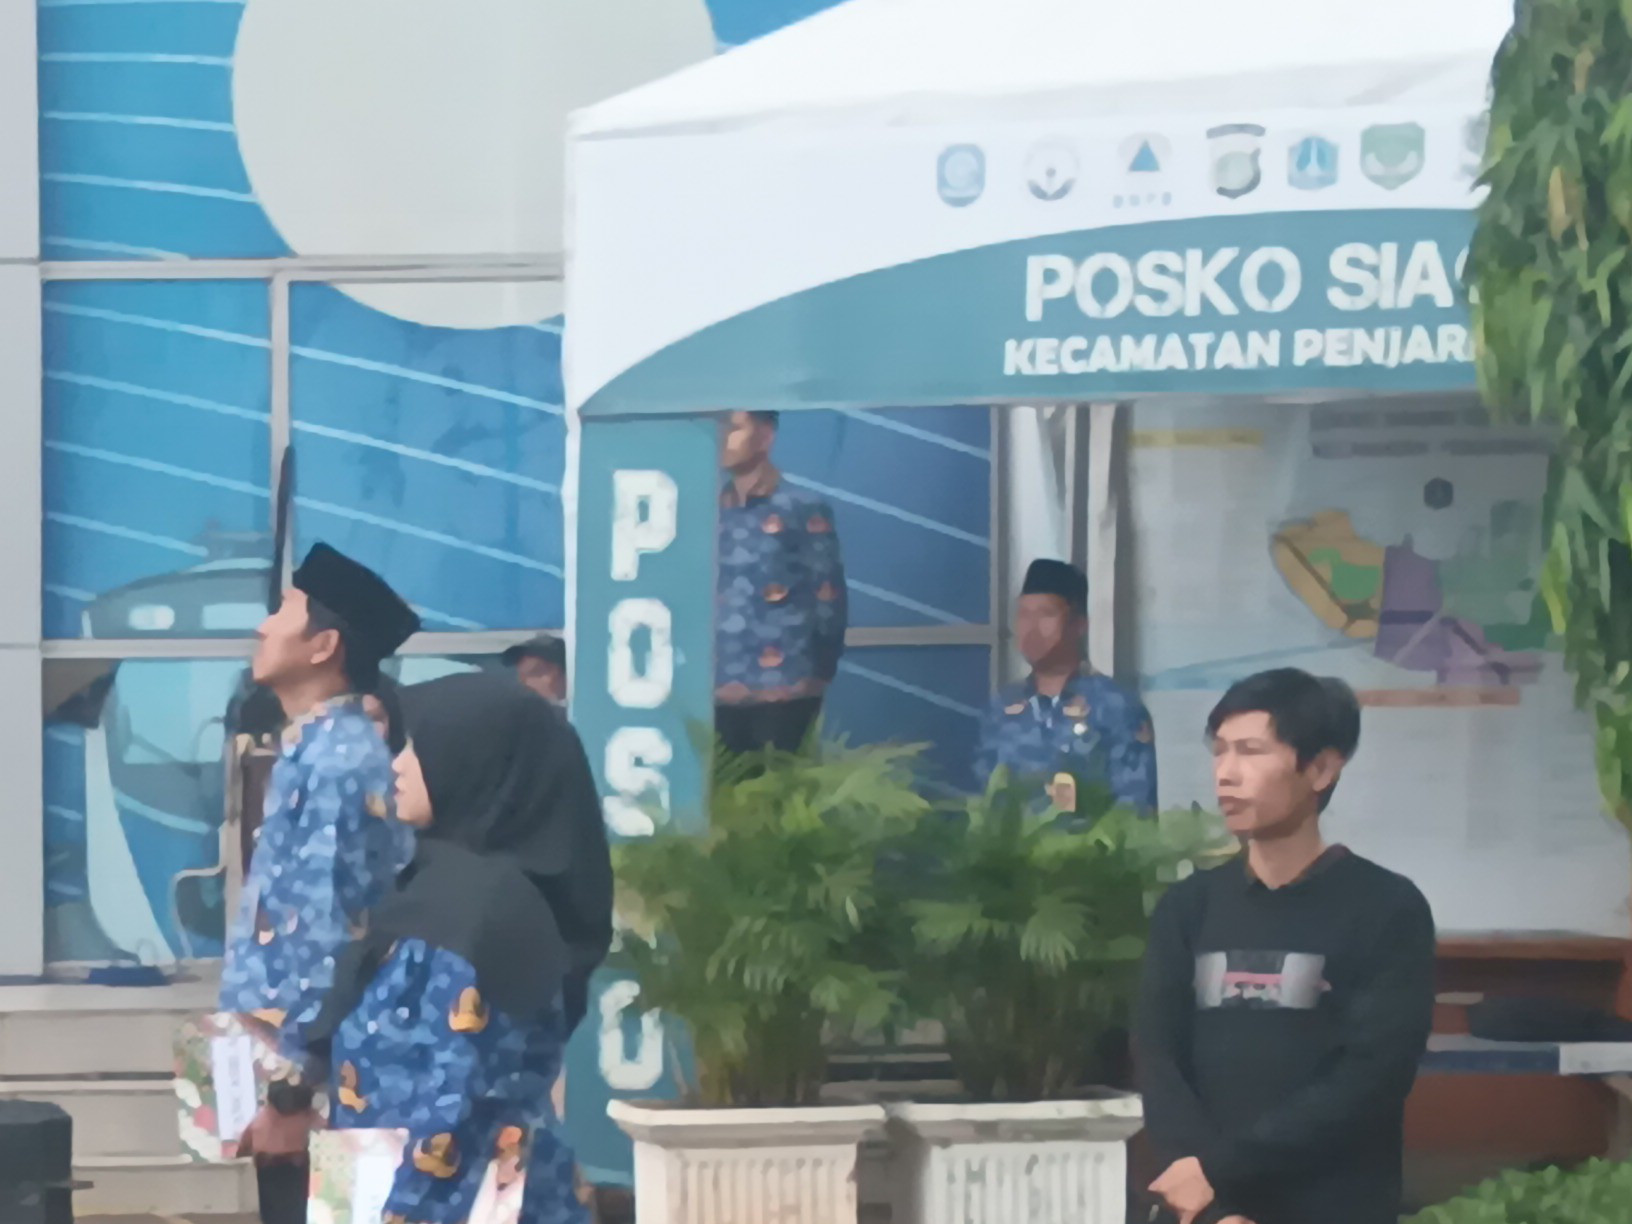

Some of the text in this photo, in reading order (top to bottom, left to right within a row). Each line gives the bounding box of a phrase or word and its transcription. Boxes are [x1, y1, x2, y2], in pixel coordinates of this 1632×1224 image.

[1025, 240, 1479, 322] POSKO SIA
[1003, 329, 1281, 376] KECAMATAN
[597, 468, 678, 1091] POSO
